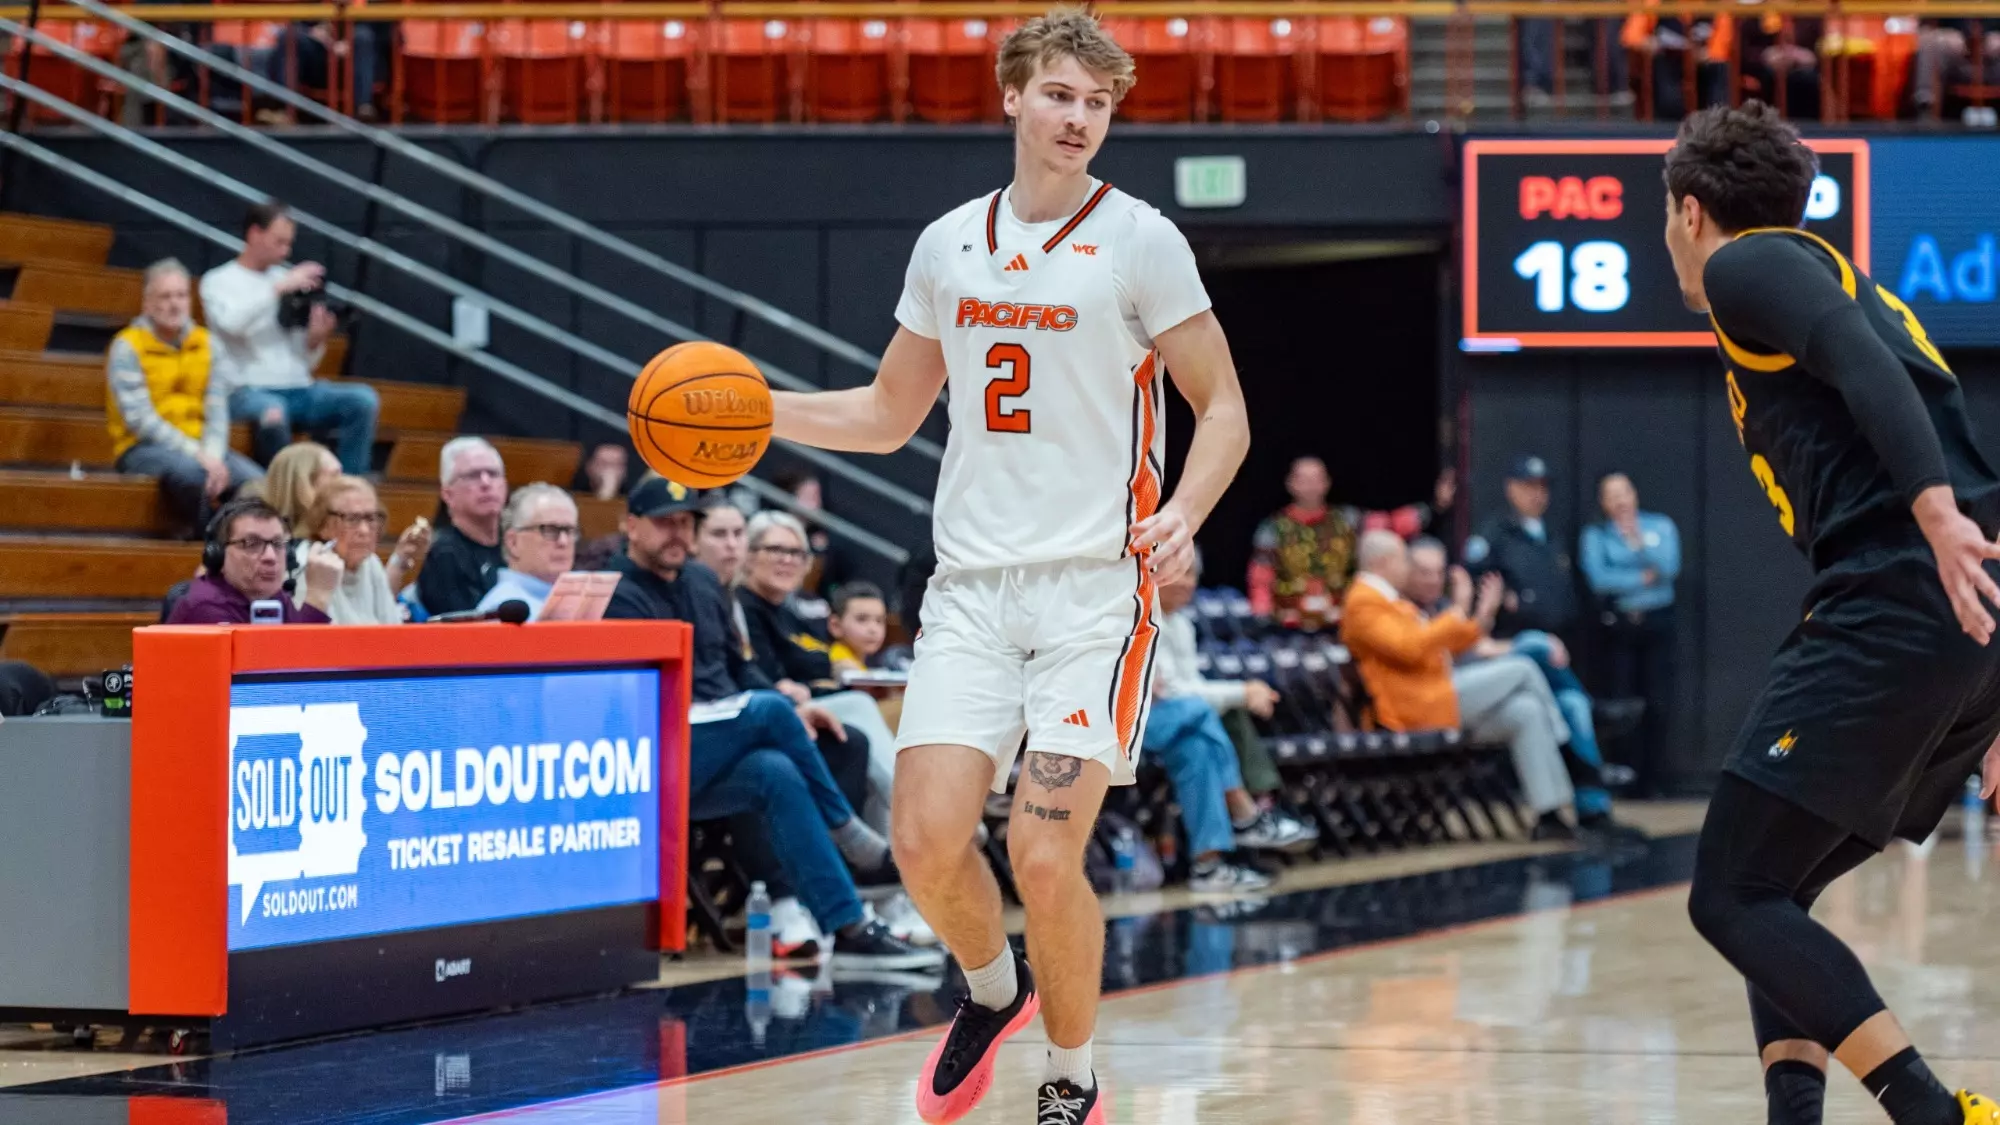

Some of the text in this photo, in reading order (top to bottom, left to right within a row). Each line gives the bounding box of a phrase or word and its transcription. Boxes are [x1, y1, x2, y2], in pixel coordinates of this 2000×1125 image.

[1519, 176, 1624, 220] PAC
[1513, 240, 1630, 312] 18
[956, 297, 1078, 332] PACIFIC
[682, 387, 769, 416] Wilson
[985, 342, 1031, 434] 2
[693, 441, 758, 460] NCAA
[237, 756, 353, 831] SOLD OUT
[374, 737, 651, 814] SOLDOUT.COM
[387, 816, 641, 870] TICKET RESALE PARTNER
[262, 884, 359, 918] SOLDOUT.COM
